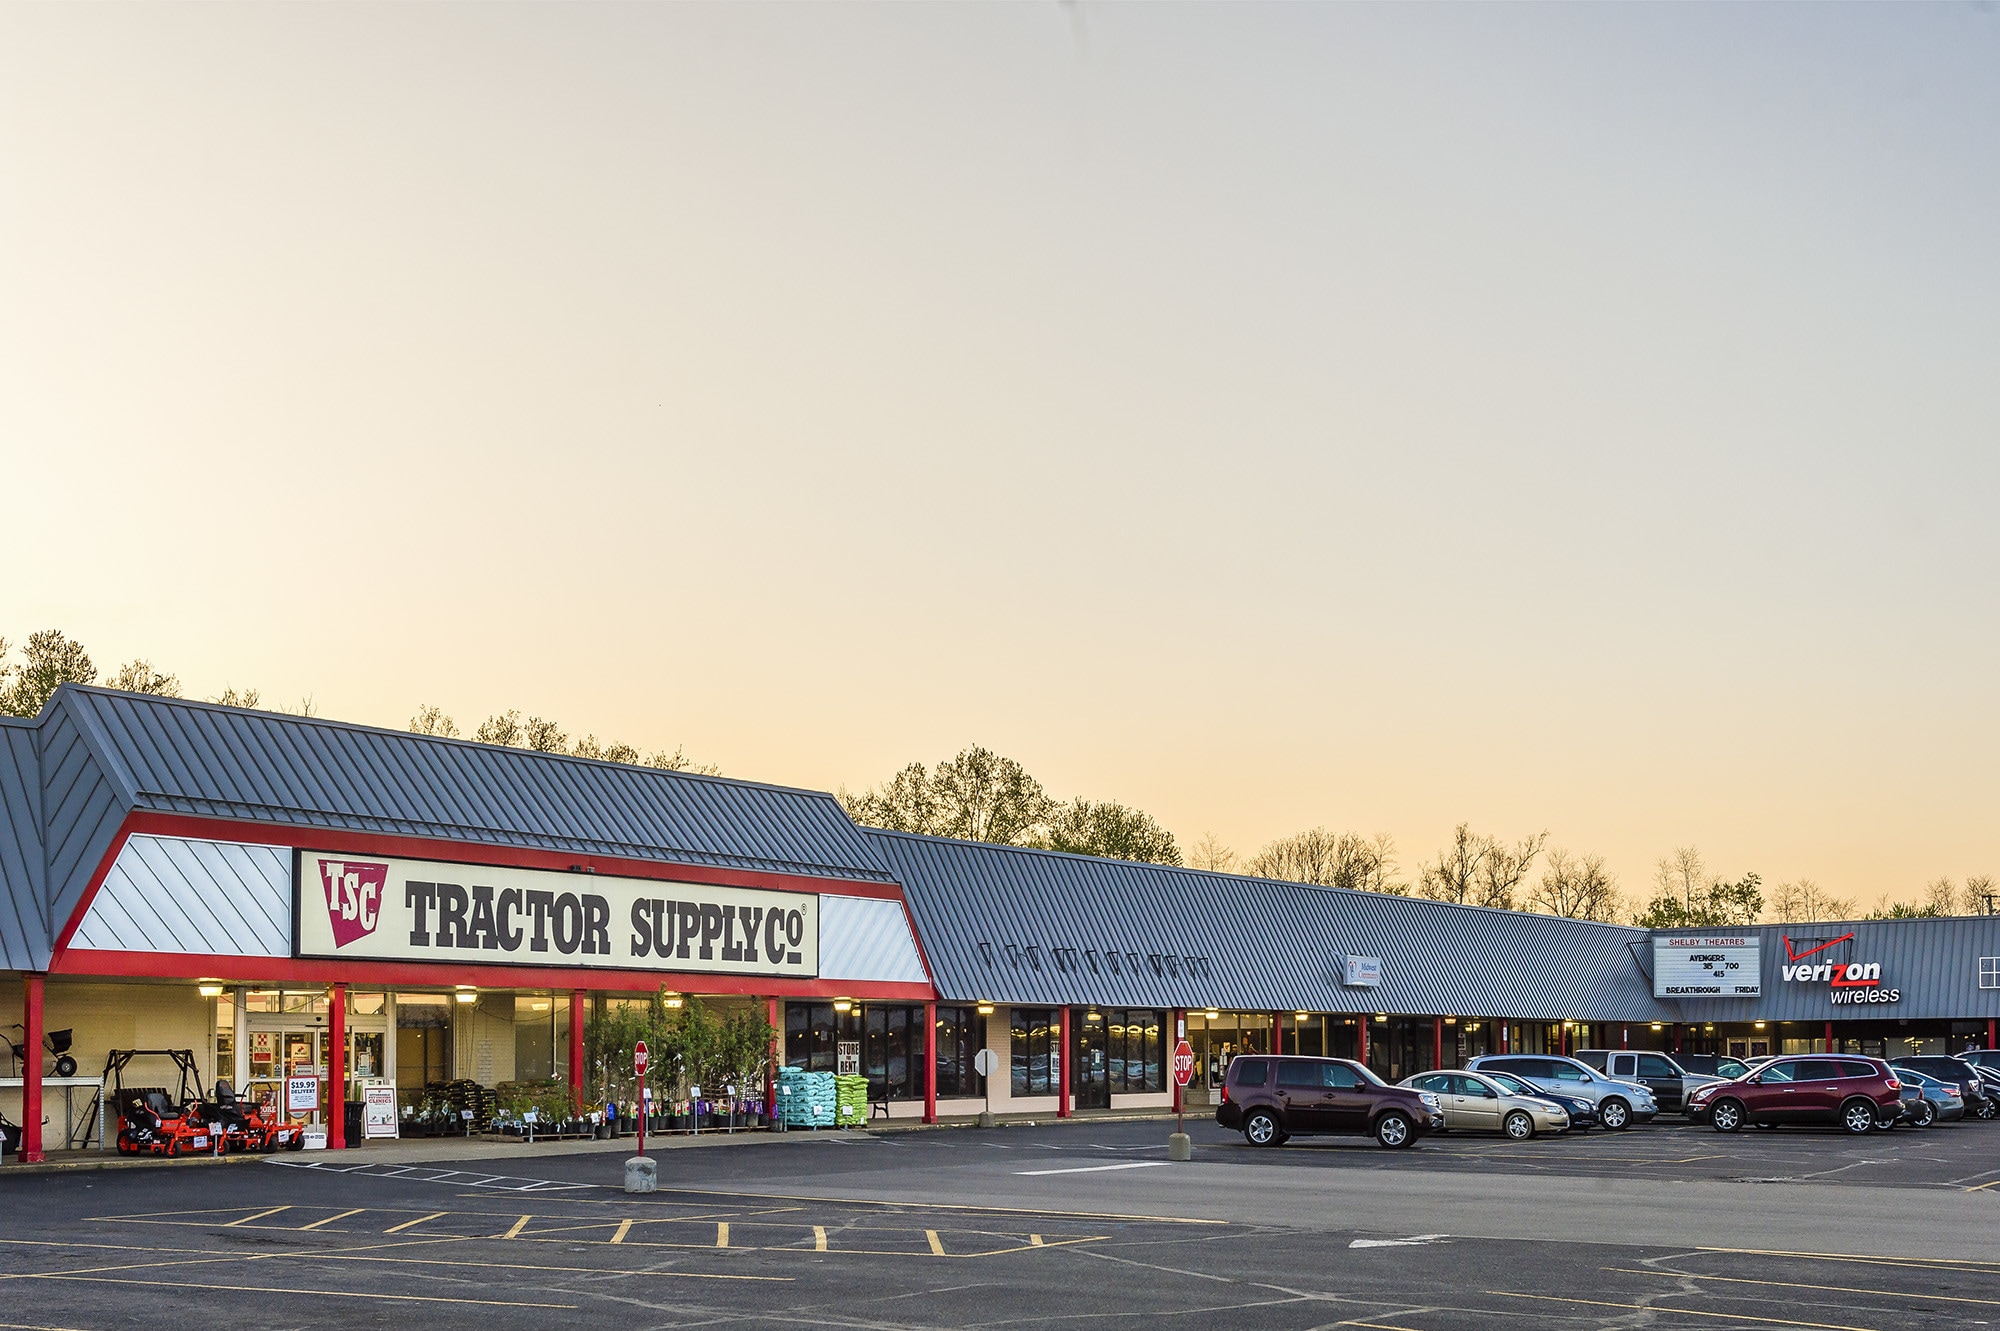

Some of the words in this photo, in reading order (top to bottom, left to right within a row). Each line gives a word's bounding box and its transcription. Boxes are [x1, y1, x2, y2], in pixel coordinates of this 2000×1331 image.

[325, 862, 377, 931] TSC
[405, 880, 610, 955] TRACTOR
[1705, 938, 1745, 946] THEATRES
[1782, 959, 1880, 987] verizon
[1735, 986, 1759, 994] FRIDAY
[1830, 987, 1900, 1004] wireless
[838, 1043, 859, 1055] STORE
[635, 1052, 647, 1065] STOP
[1175, 1055, 1192, 1071] STOP
[840, 1061, 857, 1072] RENT
[291, 1081, 315, 1089] $19.99
